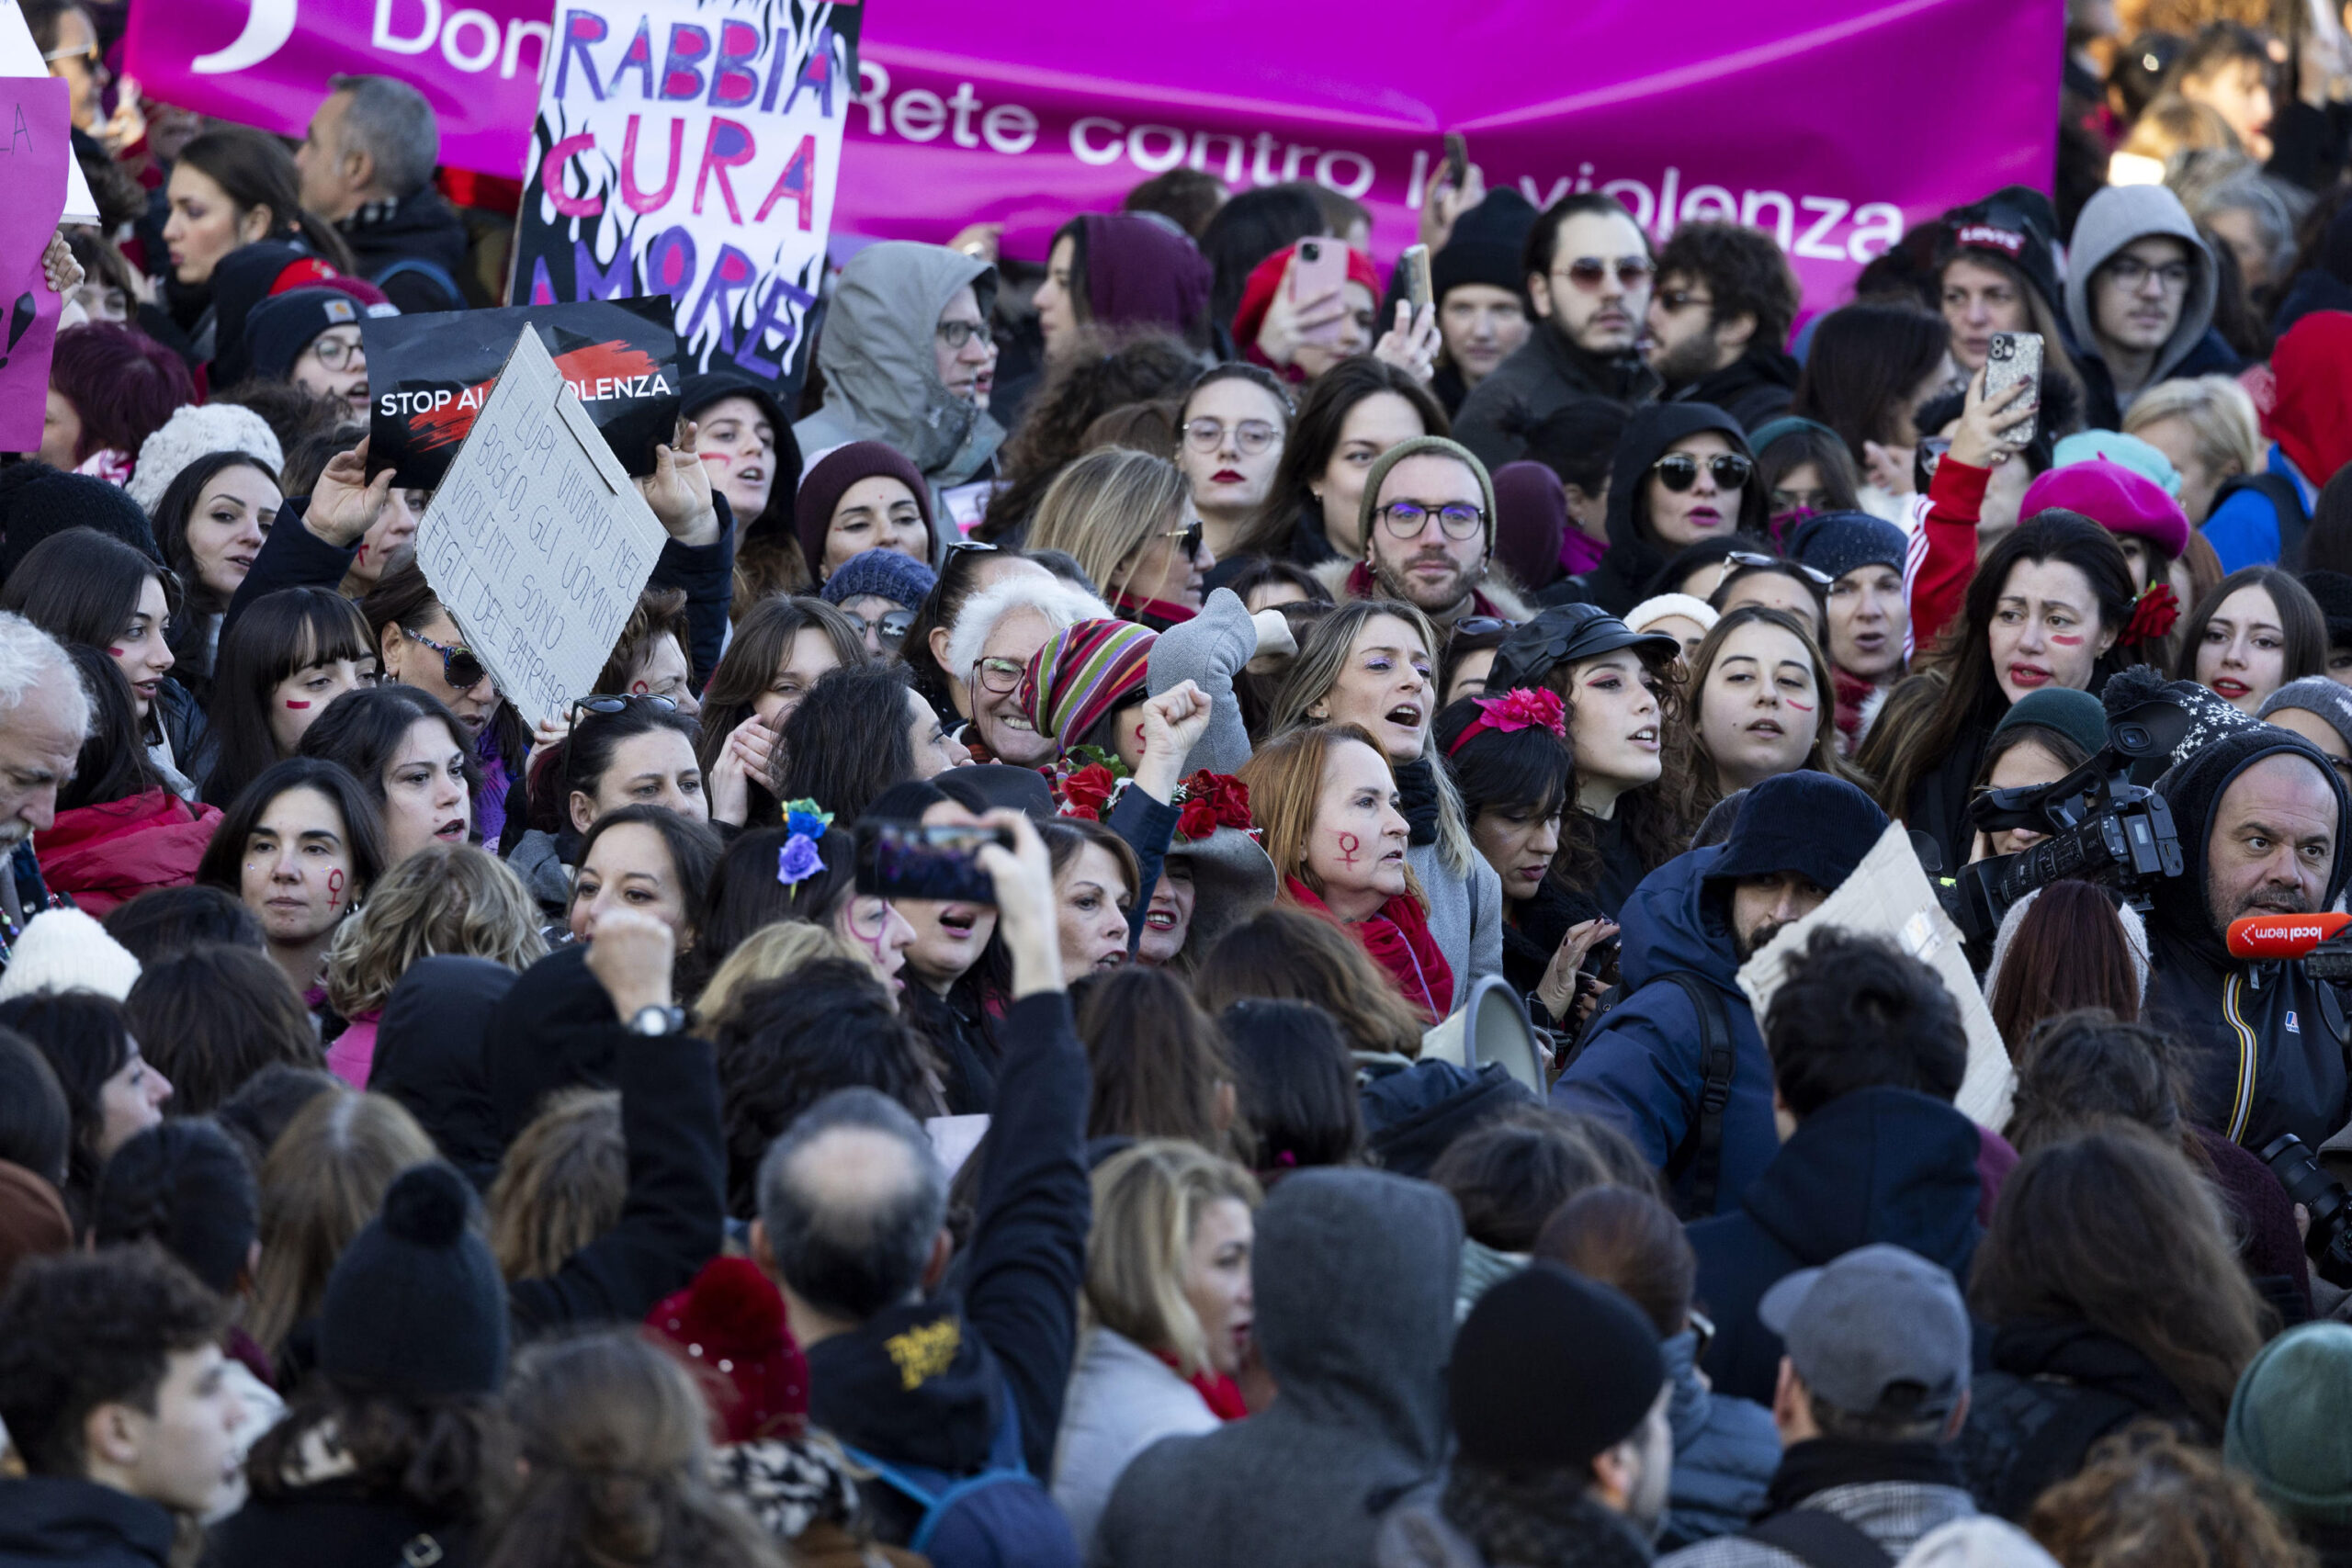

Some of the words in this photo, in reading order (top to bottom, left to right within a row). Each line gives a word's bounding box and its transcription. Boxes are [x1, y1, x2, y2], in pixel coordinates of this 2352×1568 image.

[372, 0, 552, 84] Don
[853, 60, 1039, 154] Rete
[1069, 117, 1375, 200] contro
[553, 9, 833, 118] RABBIA
[542, 114, 815, 231] CURA
[529, 225, 817, 380] AMORE
[380, 390, 451, 416] STOP
[476, 423, 527, 523] BOSCO,
[529, 504, 562, 565] GLI
[561, 551, 621, 649] UOMINI
[501, 378, 518, 410] I
[514, 400, 558, 476] LUPI
[609, 538, 642, 602] NEL
[424, 511, 473, 603] FIGLI
[473, 583, 503, 646] DEL
[452, 467, 516, 583] VIOLENTI
[514, 574, 565, 649] SONO
[2255, 927, 2288, 941] team
[2290, 926, 2323, 942] local
